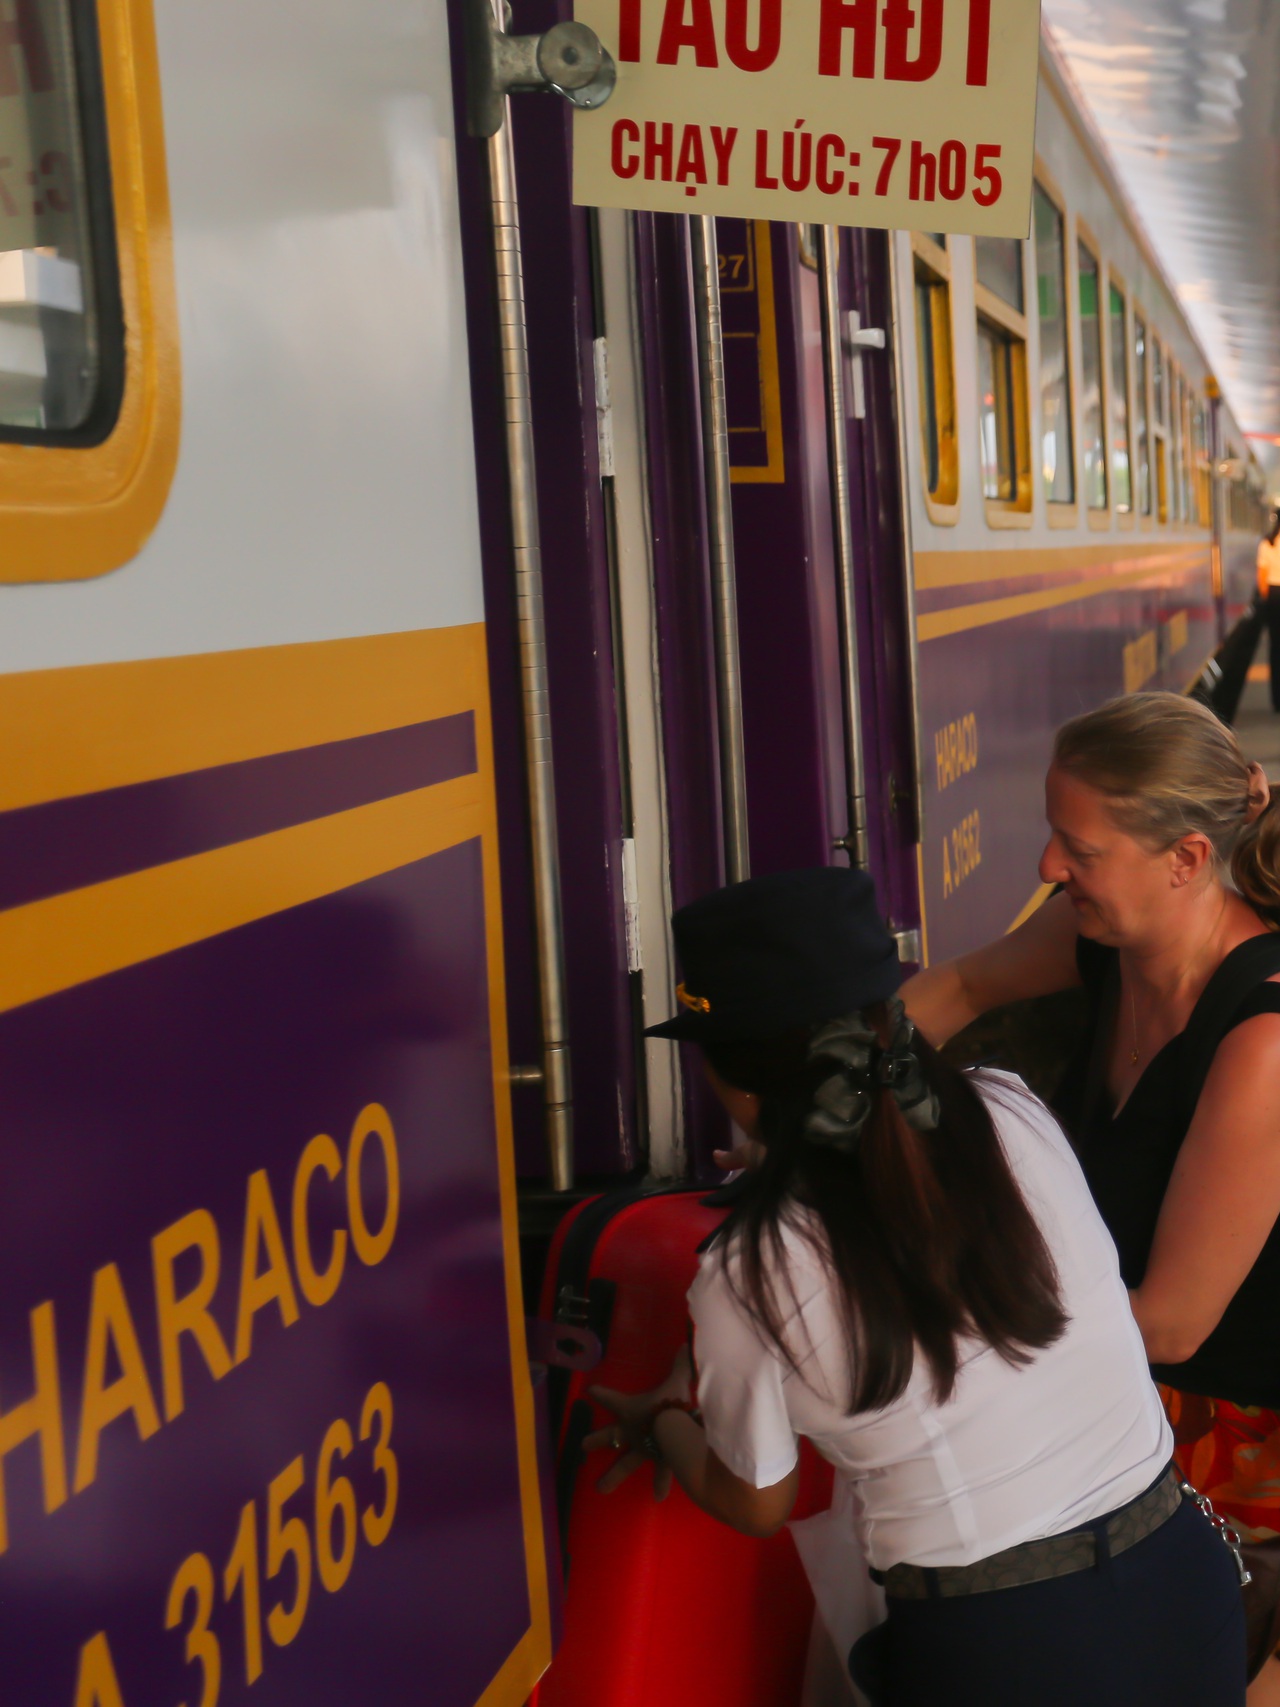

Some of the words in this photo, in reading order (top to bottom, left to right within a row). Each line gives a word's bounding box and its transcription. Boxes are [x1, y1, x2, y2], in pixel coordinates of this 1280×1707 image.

[611, 118, 738, 197] CHẠY
[755, 119, 861, 196] LÚC:
[935, 711, 978, 792] HARACO
[0, 1102, 399, 1556] HARACO
[165, 1381, 398, 1707] 31563
